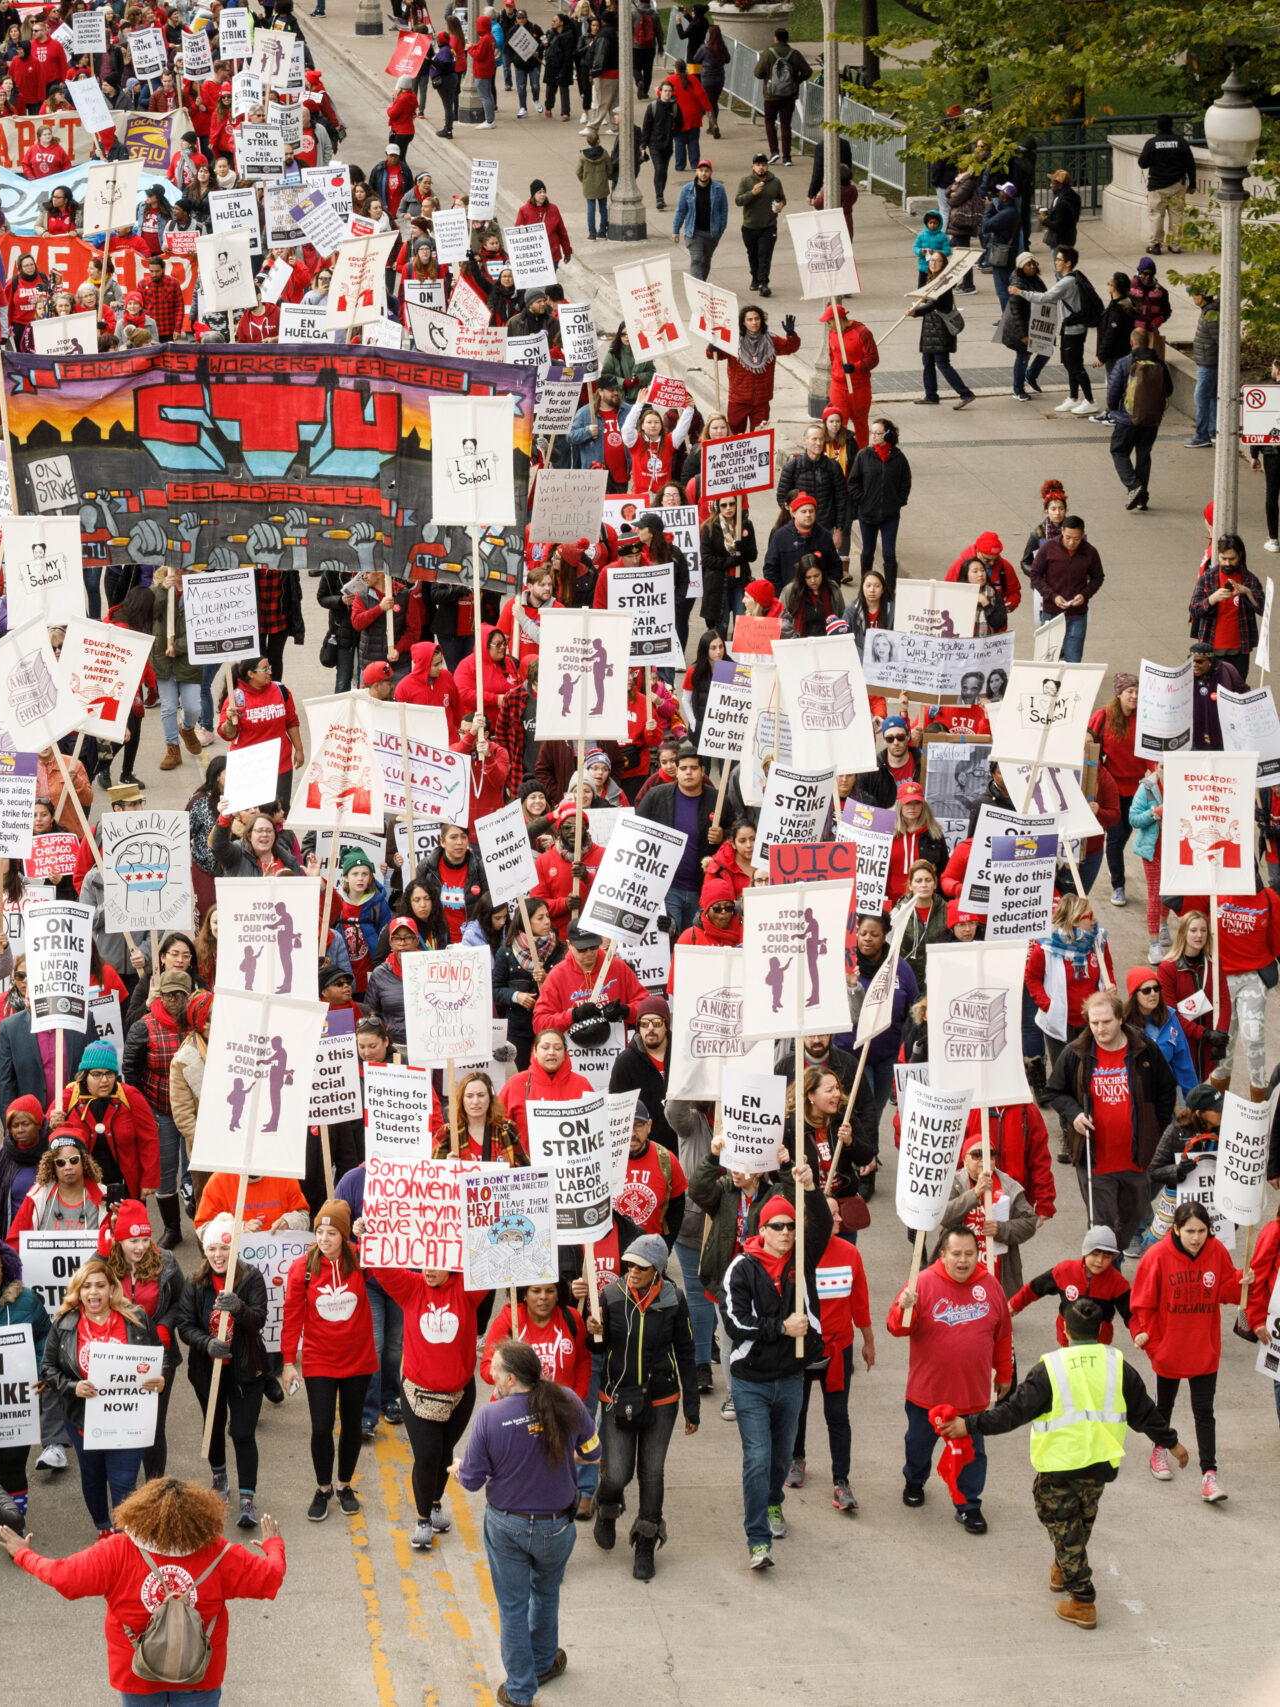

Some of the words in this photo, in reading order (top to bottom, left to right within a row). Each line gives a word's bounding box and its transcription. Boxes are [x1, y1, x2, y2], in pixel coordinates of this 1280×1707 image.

[156, 119, 168, 127] 73
[254, 131, 269, 139] ON
[247, 138, 278, 147] STRIKE
[35, 153, 54, 163] CTU
[129, 146, 167, 161] SEIU
[508, 235, 538, 245] TEACHERS
[512, 242, 542, 252] STUDENTS
[1040, 305, 1051, 317] ON
[1031, 319, 1055, 334] STRIKE
[61, 356, 189, 380] FAMILIES
[210, 358, 317, 372] WORKERS
[340, 358, 464, 389] TEACHERS
[1245, 435, 1264, 443] TOW
[720, 448, 757, 460] PROBLEMS
[455, 460, 460, 472] I
[476, 458, 489, 469] MY
[712, 459, 727, 469] AND
[729, 458, 747, 467] CUTS
[35, 464, 62, 479] ON
[715, 465, 755, 477] EDUCATION
[458, 472, 491, 486] School
[707, 476, 735, 487] CAUSED
[738, 472, 757, 481] THEM
[36, 478, 75, 502] STRIKE
[170, 483, 364, 502] SOLIDARITY
[1188, 784, 1236, 795] STUDENTS,
[1191, 805, 1230, 814] PARENTS
[1194, 815, 1227, 823] UNITED
[635, 839, 662, 857] ON
[614, 849, 670, 878] STRIKE
[777, 845, 850, 873] UIC
[620, 878, 649, 895] FAIR
[598, 884, 659, 913] CONTRACT
[46, 918, 73, 933] ON
[33, 935, 84, 952] STRIKE
[40, 959, 78, 972] UNFAIR
[42, 970, 78, 982] LABOR
[34, 980, 84, 996] PRACTICES
[368, 1085, 408, 1099] Fighting
[412, 1090, 427, 1099] for
[368, 1098, 385, 1110] the
[387, 1101, 428, 1111] Schools
[741, 1094, 761, 1108] EN
[373, 1110, 422, 1124] Chicago's
[723, 1108, 782, 1126] HUELGA
[375, 1122, 420, 1133] Students
[376, 1133, 420, 1145] Deserve!
[727, 1131, 775, 1146] contrato
[734, 1143, 763, 1156] justo
[93, 1352, 106, 1360] PUT
[1069, 1356, 1097, 1370] IFT
[109, 1373, 137, 1384] FAIR
[103, 1402, 139, 1413] NOW!
